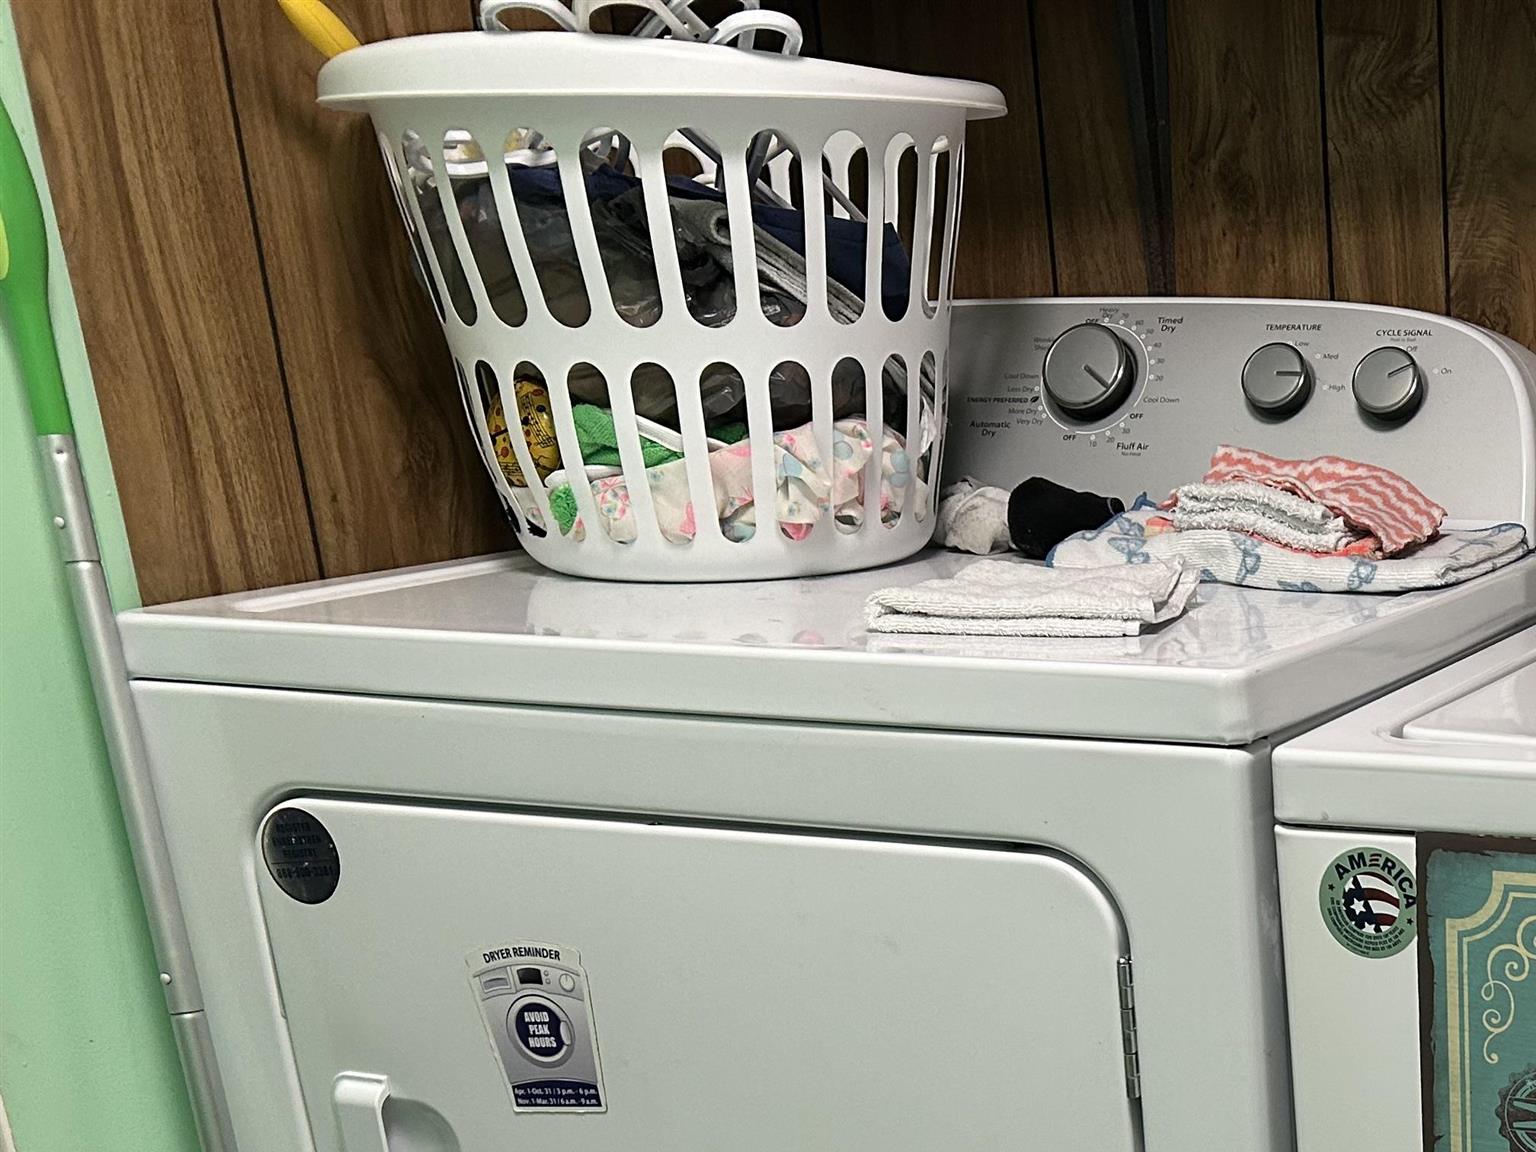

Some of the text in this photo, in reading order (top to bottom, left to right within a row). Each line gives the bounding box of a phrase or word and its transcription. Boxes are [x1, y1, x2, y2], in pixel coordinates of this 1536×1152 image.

[1161, 325, 1176, 333] Dry
[1376, 329, 1433, 337] CYCLE SIGNAL
[1329, 384, 1346, 392] High
[969, 421, 1011, 429] Automatic
[981, 429, 996, 437] Dry
[1116, 442, 1136, 450] Fluff
[1334, 852, 1416, 909] AMERICA
[482, 946, 561, 964] DRYER REMINDER
[524, 1011, 550, 1023] AVOID
[528, 1024, 550, 1035] PEAK
[528, 1037, 557, 1048] HOURS
